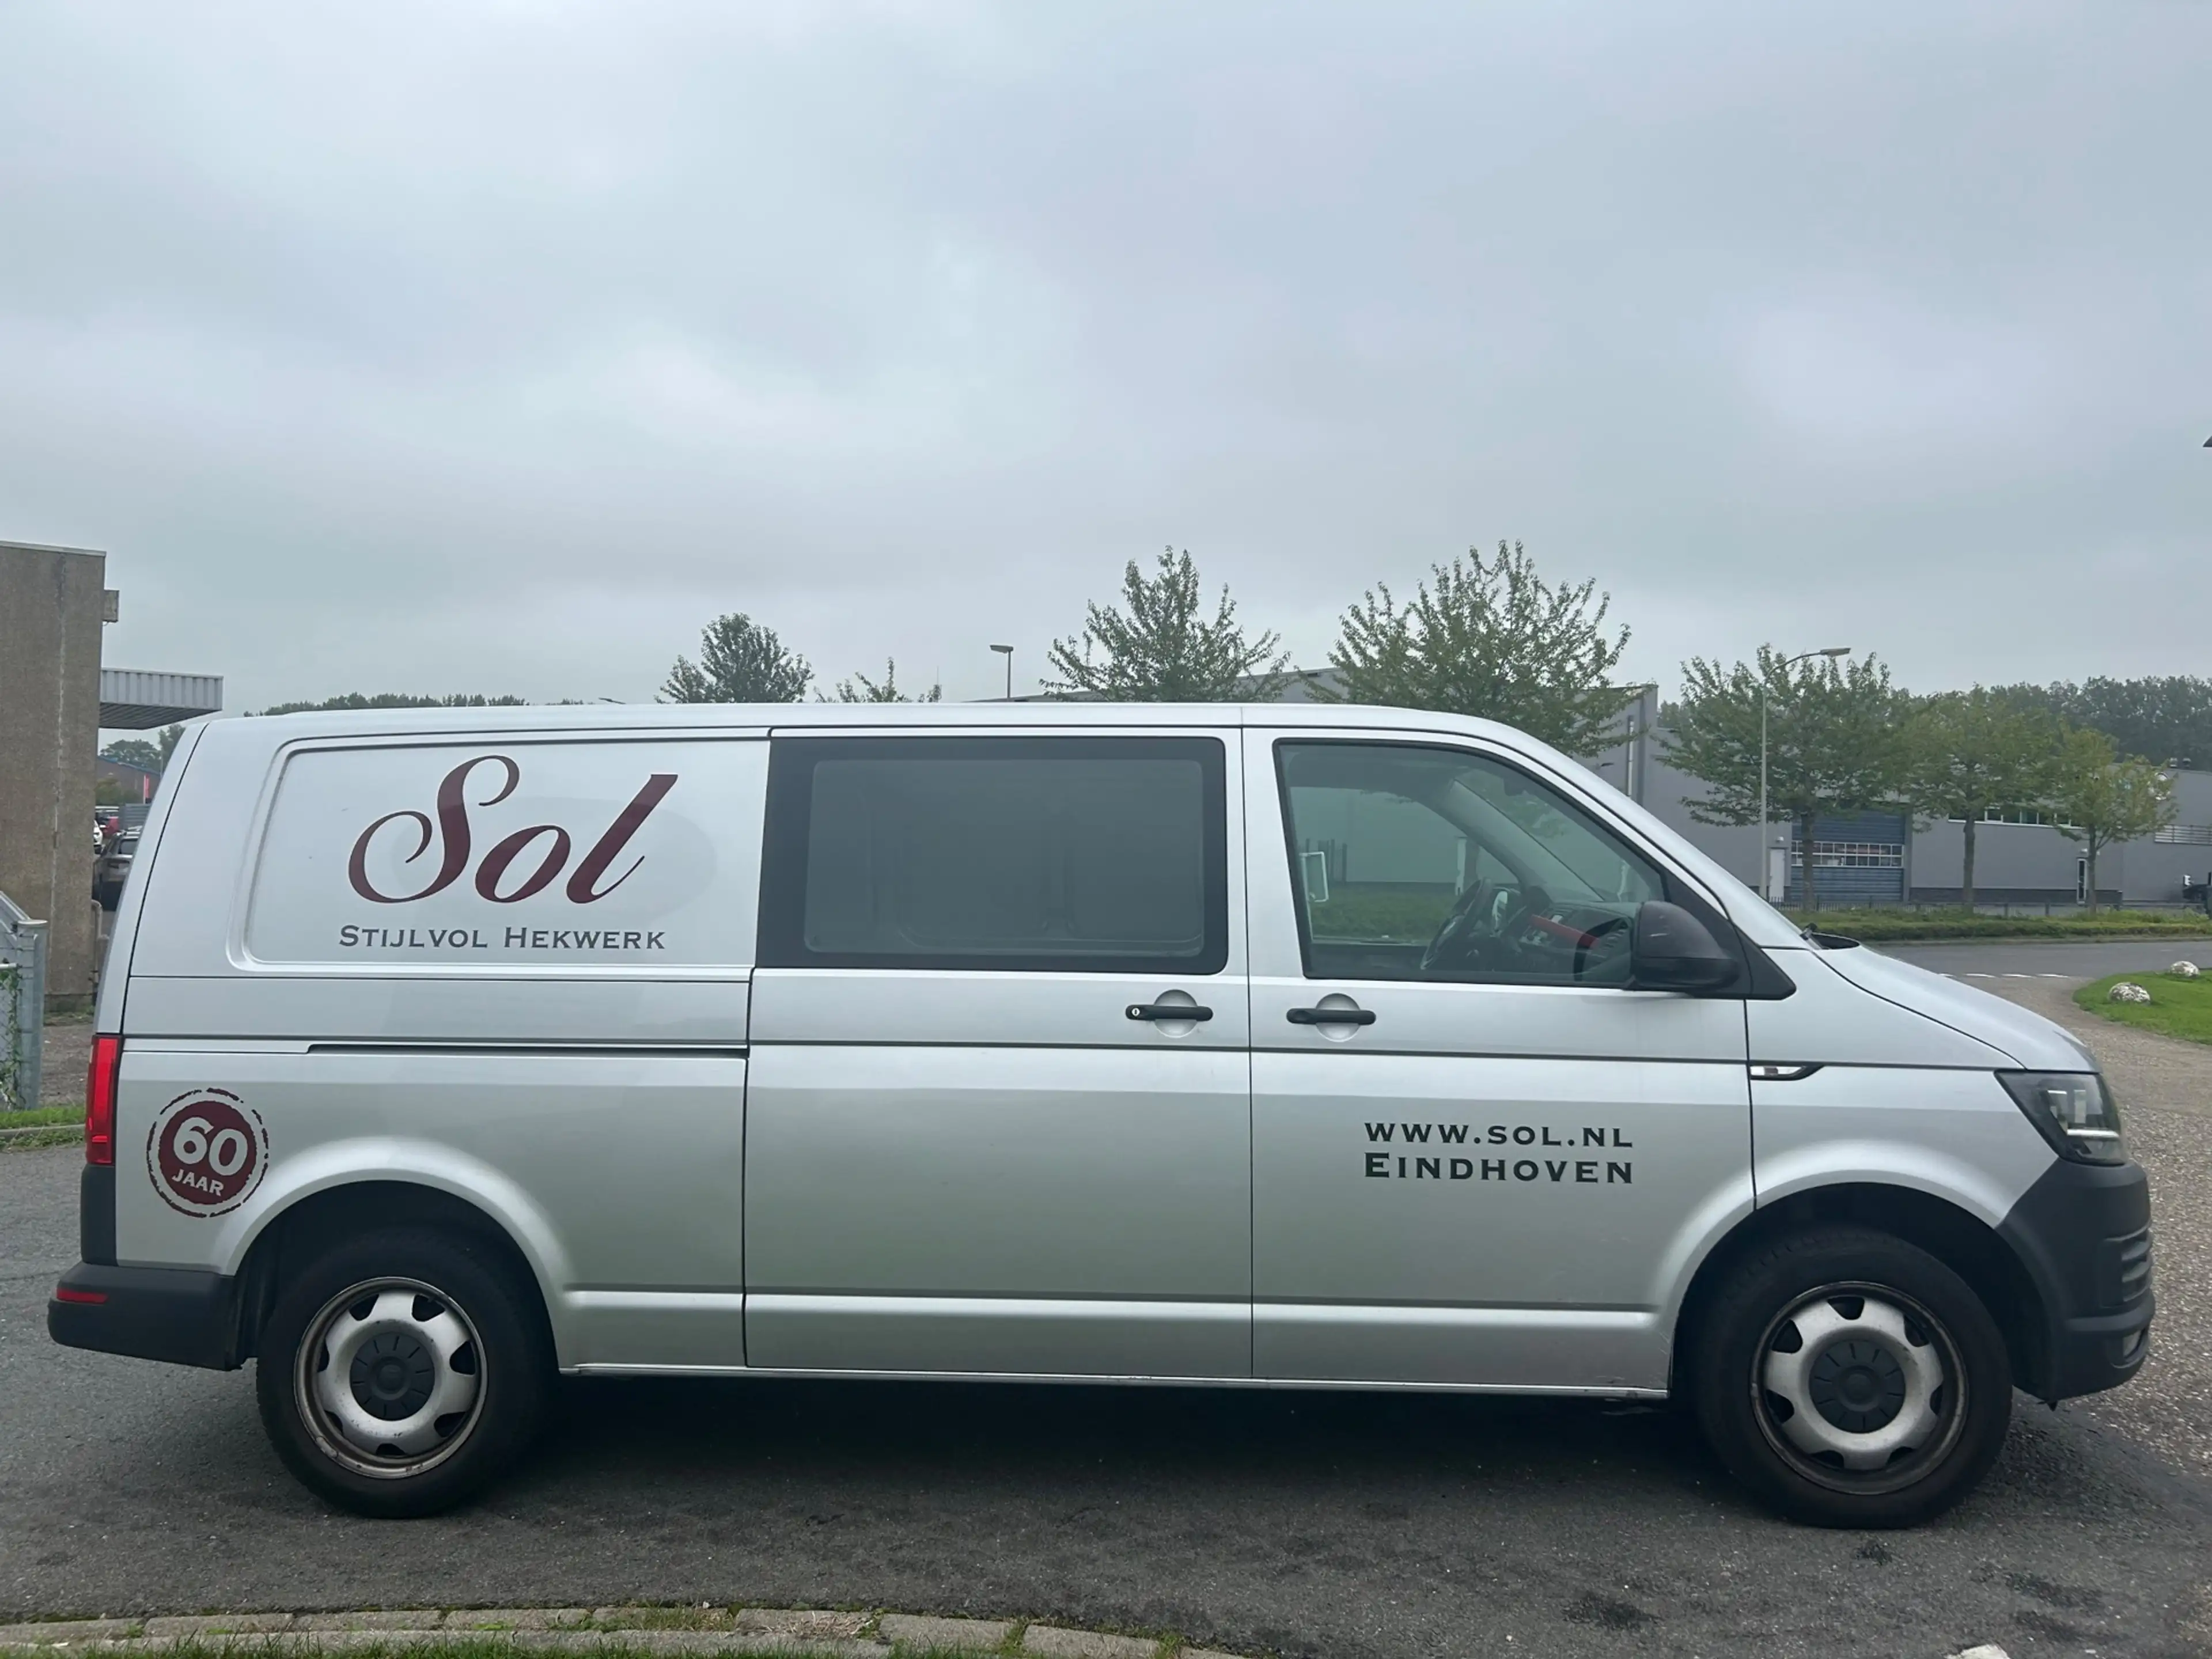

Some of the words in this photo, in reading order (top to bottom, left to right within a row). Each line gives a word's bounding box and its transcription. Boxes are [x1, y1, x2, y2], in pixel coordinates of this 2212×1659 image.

[348, 755, 679, 903] Sol
[339, 925, 488, 948] STIJLVOL
[503, 927, 666, 949] HEKWERK
[173, 1116, 248, 1176] 60
[1364, 1123, 1633, 1147] WWW.SOL.NL
[172, 1169, 224, 1196] JAAR
[1364, 1152, 1633, 1184] EINDHOVEN
